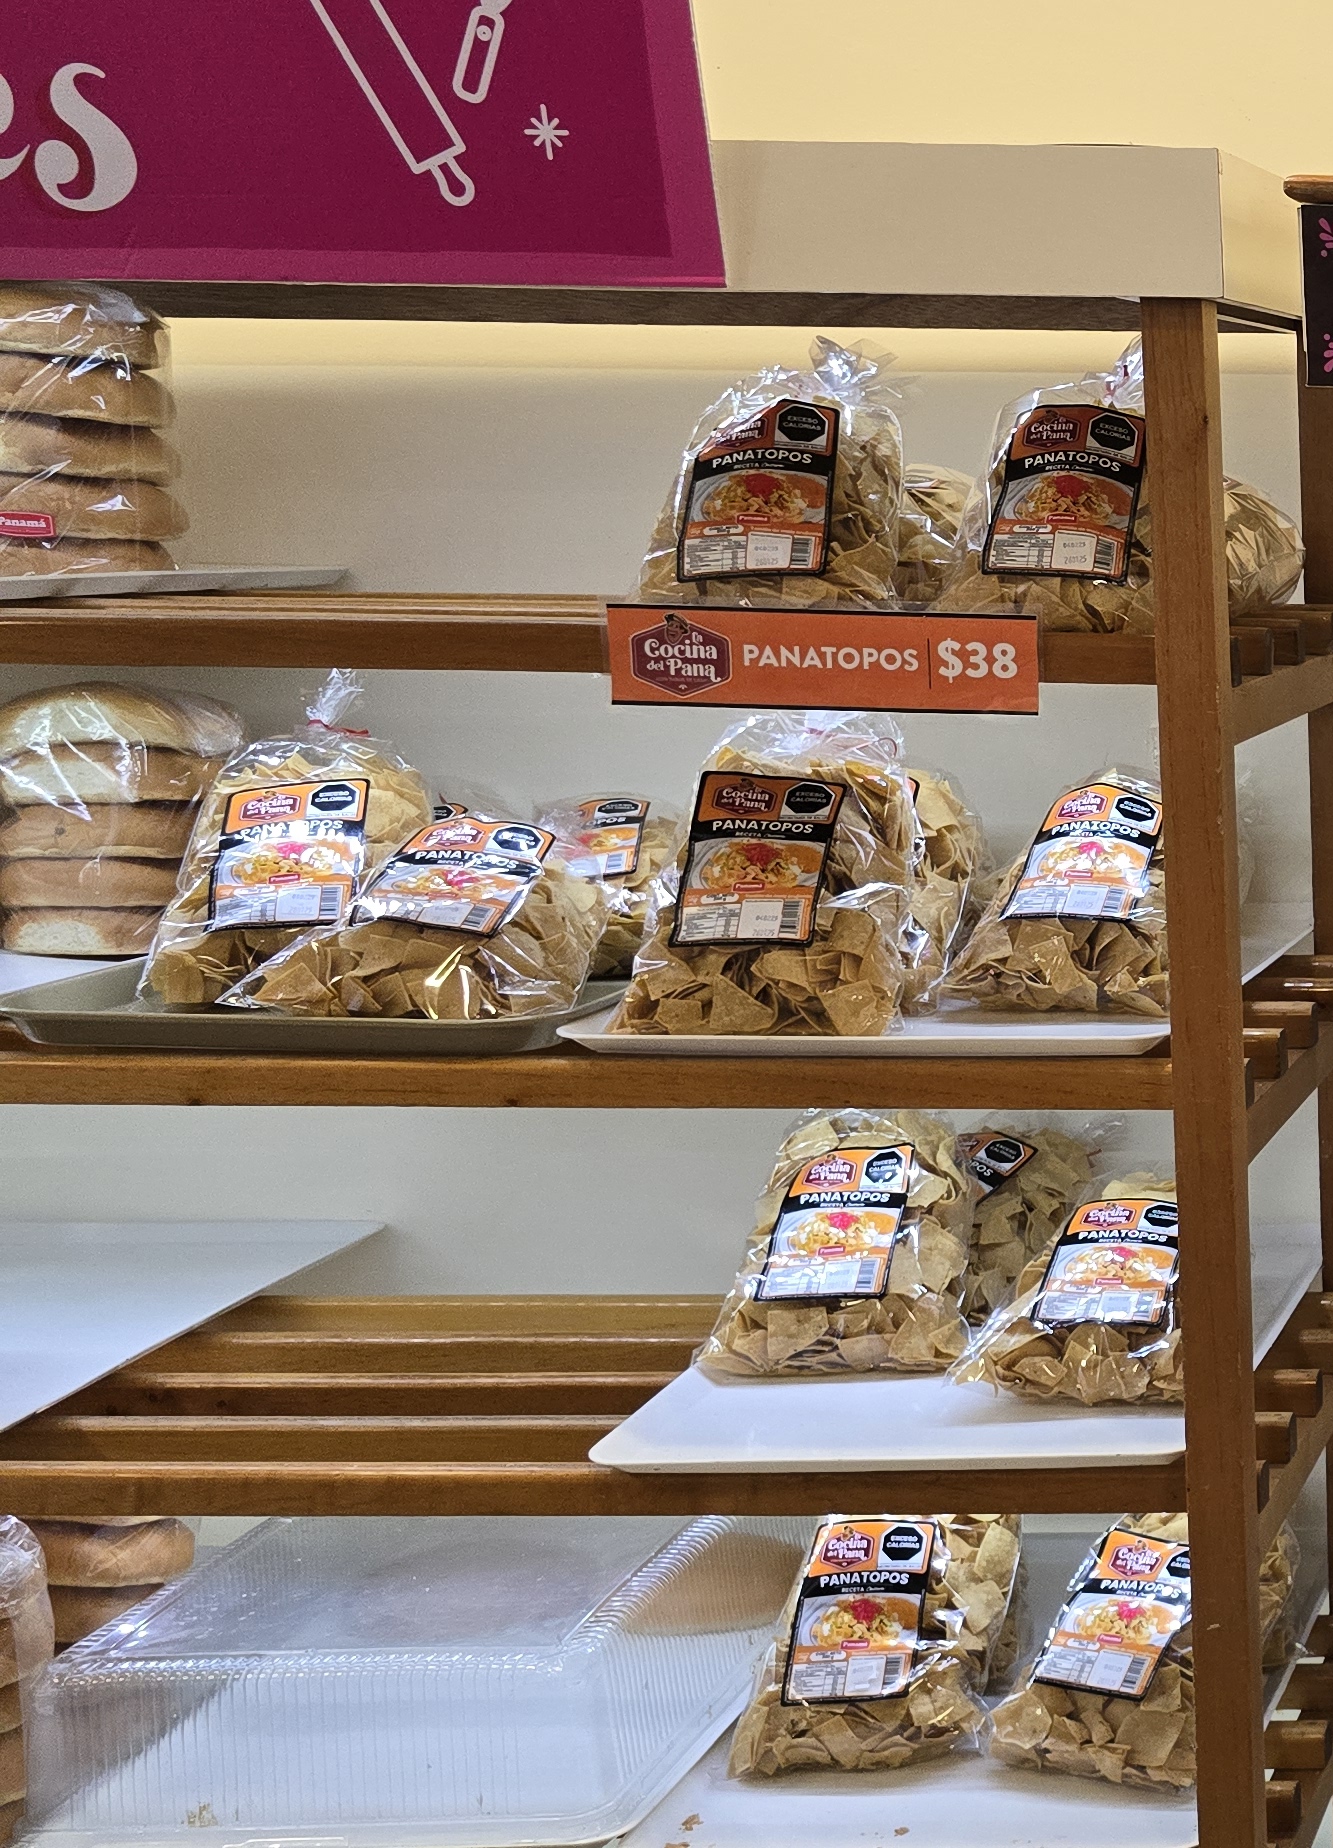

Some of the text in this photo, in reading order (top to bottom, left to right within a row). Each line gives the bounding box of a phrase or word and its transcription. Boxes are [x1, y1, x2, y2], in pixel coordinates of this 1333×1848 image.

[1030, 421, 1074, 432] Cocina
[712, 449, 813, 468] PANATOPOS
[1024, 451, 1122, 472] PANATOPOS
[644, 638, 718, 659] Cocina
[743, 638, 1018, 683] PANATOPOS $38
[646, 658, 722, 682] del Pana
[722, 788, 769, 800] Cocina
[734, 797, 769, 811] Pana
[241, 820, 344, 839] PANAPOS
[712, 819, 814, 834] PANATOPOS
[1051, 821, 1141, 838] PANATOPOS
[800, 1191, 891, 1205] PANATOPOS
[1078, 1229, 1168, 1243] PANATOPOS
[820, 1571, 910, 1588] PANATOPOS
[1100, 1579, 1182, 1599] PANATOPS
